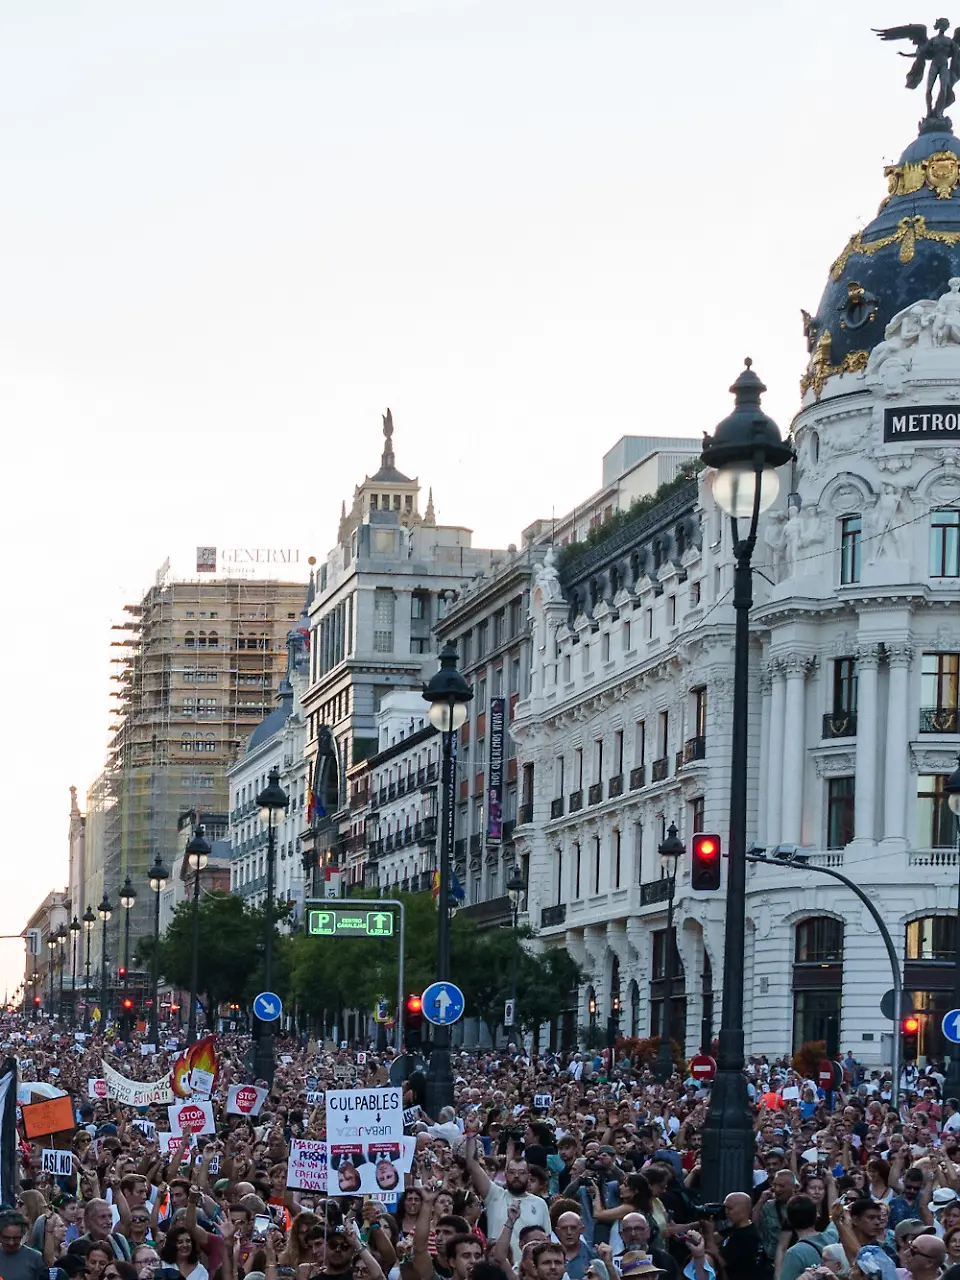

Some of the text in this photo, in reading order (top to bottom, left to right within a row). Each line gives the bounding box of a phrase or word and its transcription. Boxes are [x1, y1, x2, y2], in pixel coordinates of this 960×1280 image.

[892, 413, 960, 433] METRO
[491, 712, 503, 786] NOS QUEREMOS VIVAS
[318, 913, 330, 928] P
[329, 1093, 399, 1111] CULPABLES
[179, 1110, 203, 1120] STOP
[60, 1155, 71, 1174] NO
